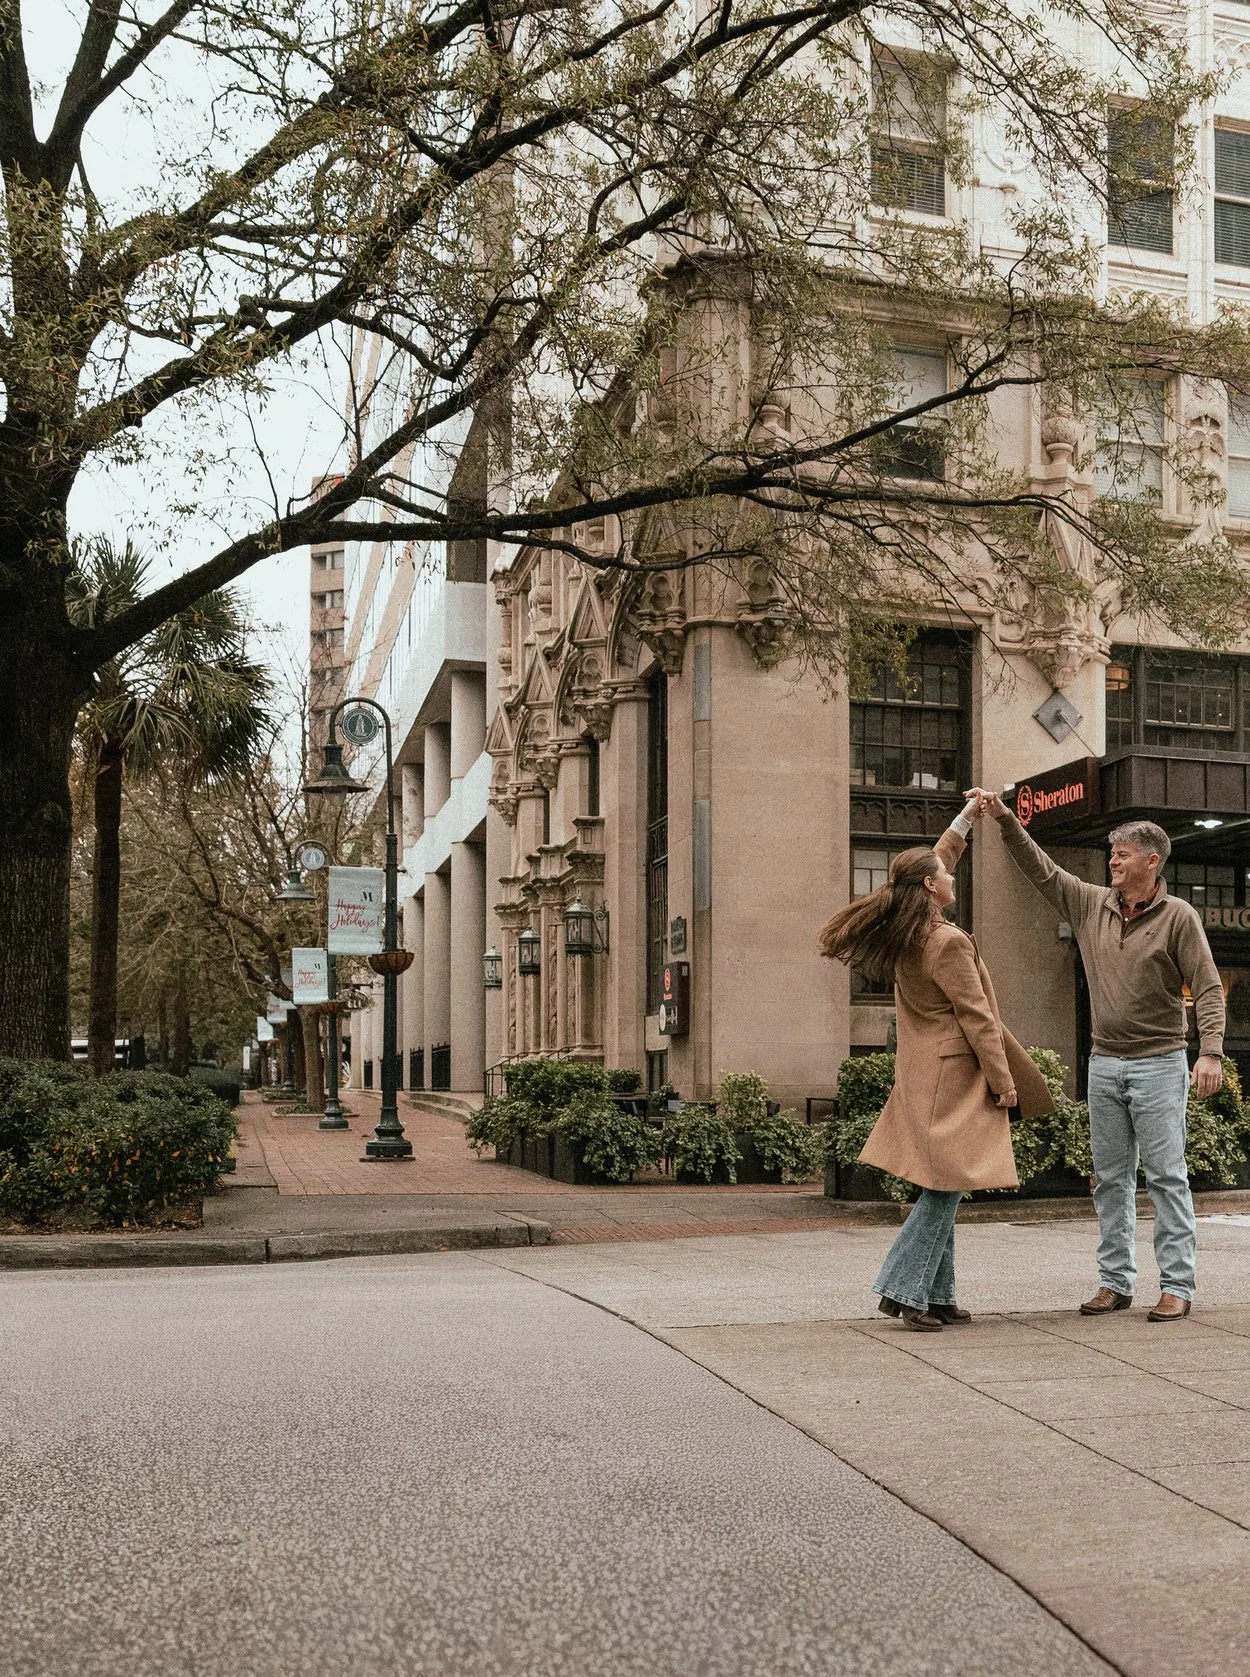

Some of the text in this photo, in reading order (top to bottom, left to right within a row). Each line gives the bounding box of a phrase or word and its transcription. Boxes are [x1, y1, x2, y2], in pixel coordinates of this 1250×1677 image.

[1033, 782, 1083, 813] Sheraton
[335, 897, 366, 916] Happy
[330, 912, 380, 933] Holidays!
